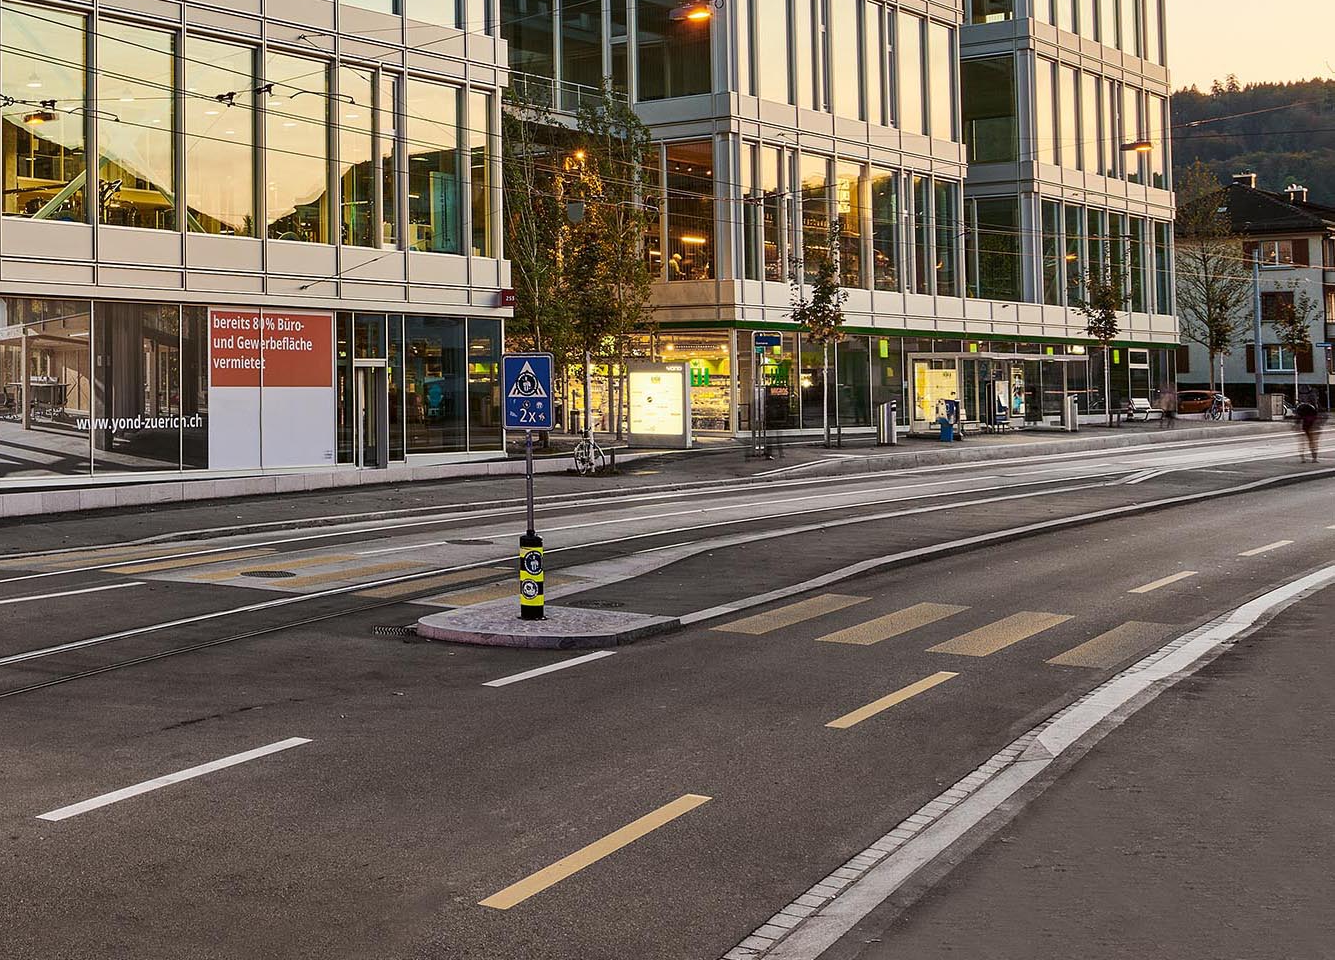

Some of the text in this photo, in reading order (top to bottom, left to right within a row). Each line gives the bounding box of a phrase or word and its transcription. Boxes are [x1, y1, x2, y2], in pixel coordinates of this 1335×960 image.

[213, 314, 251, 330] bereits
[277, 318, 305, 332] Büro-
[213, 335, 313, 351] und Gewerbefläche
[213, 355, 266, 369] vermietet
[76, 413, 203, 434] www.yond-zuerich.ch
[519, 408, 537, 423] 2x
